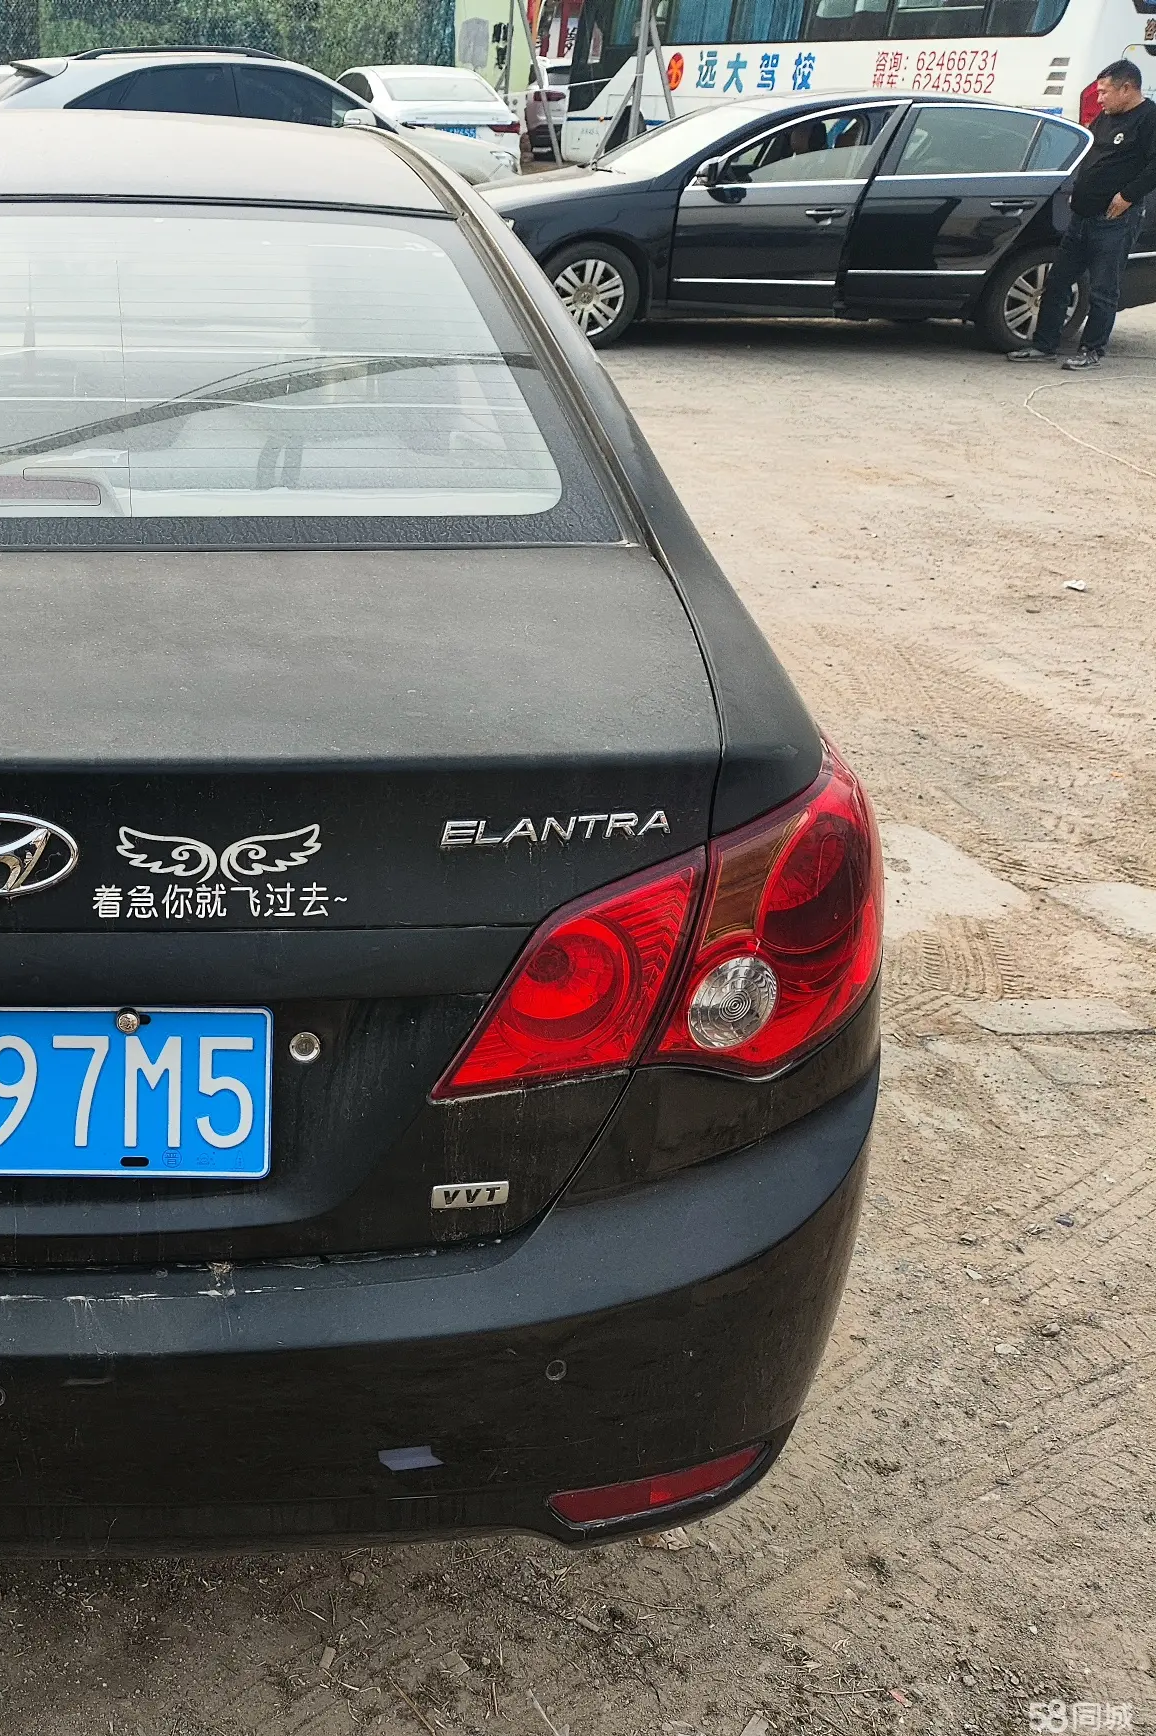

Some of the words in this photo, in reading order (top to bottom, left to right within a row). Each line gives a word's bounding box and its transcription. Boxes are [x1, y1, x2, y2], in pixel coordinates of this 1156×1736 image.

[696, 50, 817, 93] 远大驾校
[440, 810, 671, 847] ELANTRA
[92, 882, 348, 920] 着急你就飞过去~
[443, 1186, 501, 1205] VVT
